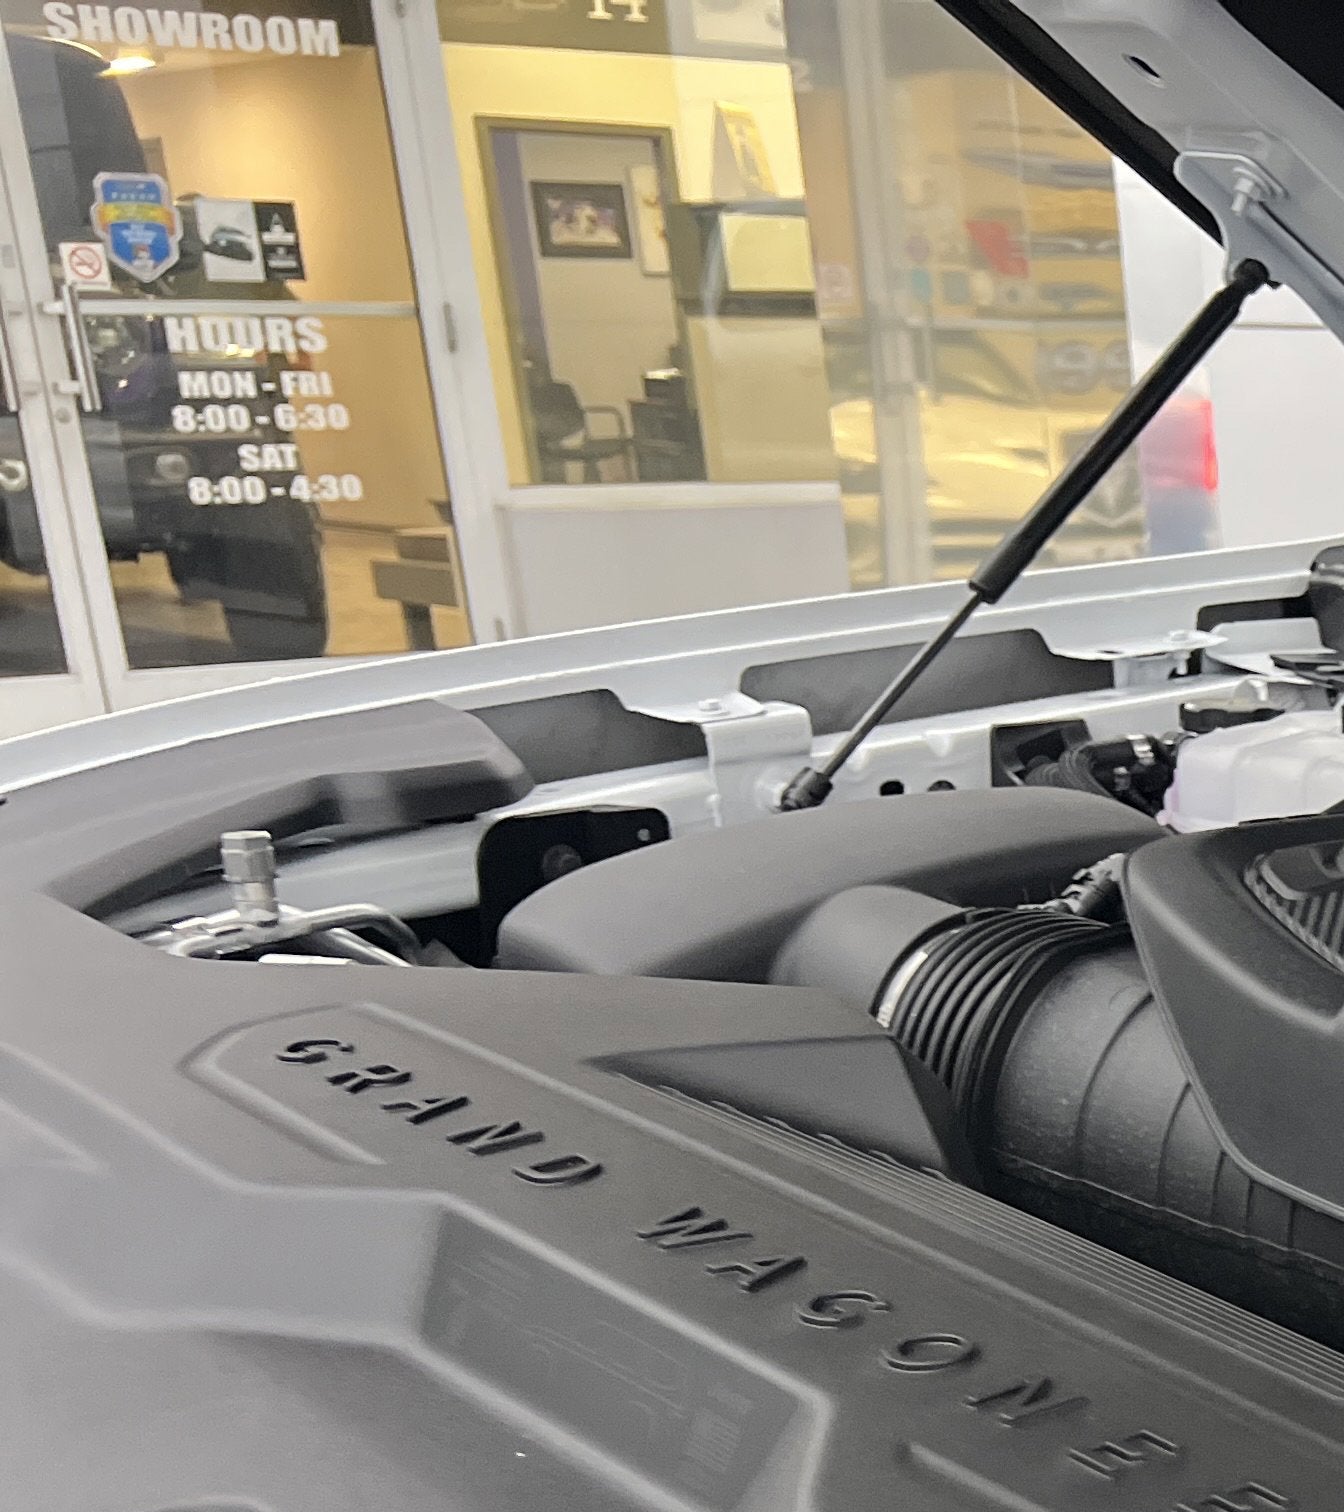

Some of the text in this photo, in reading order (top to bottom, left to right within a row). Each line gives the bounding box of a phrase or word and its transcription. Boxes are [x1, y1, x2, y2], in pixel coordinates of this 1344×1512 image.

[43, 1, 340, 57] SHOWROOM
[165, 316, 328, 354] HOURS
[178, 371, 257, 399] MON
[280, 370, 334, 397] FRI
[171, 405, 251, 433] 8:00
[273, 404, 350, 430] 6:30
[237, 443, 298, 472] SAT
[188, 477, 268, 505] 8:00
[289, 475, 364, 501] 4:30
[276, 1037, 604, 1187] GRAND
